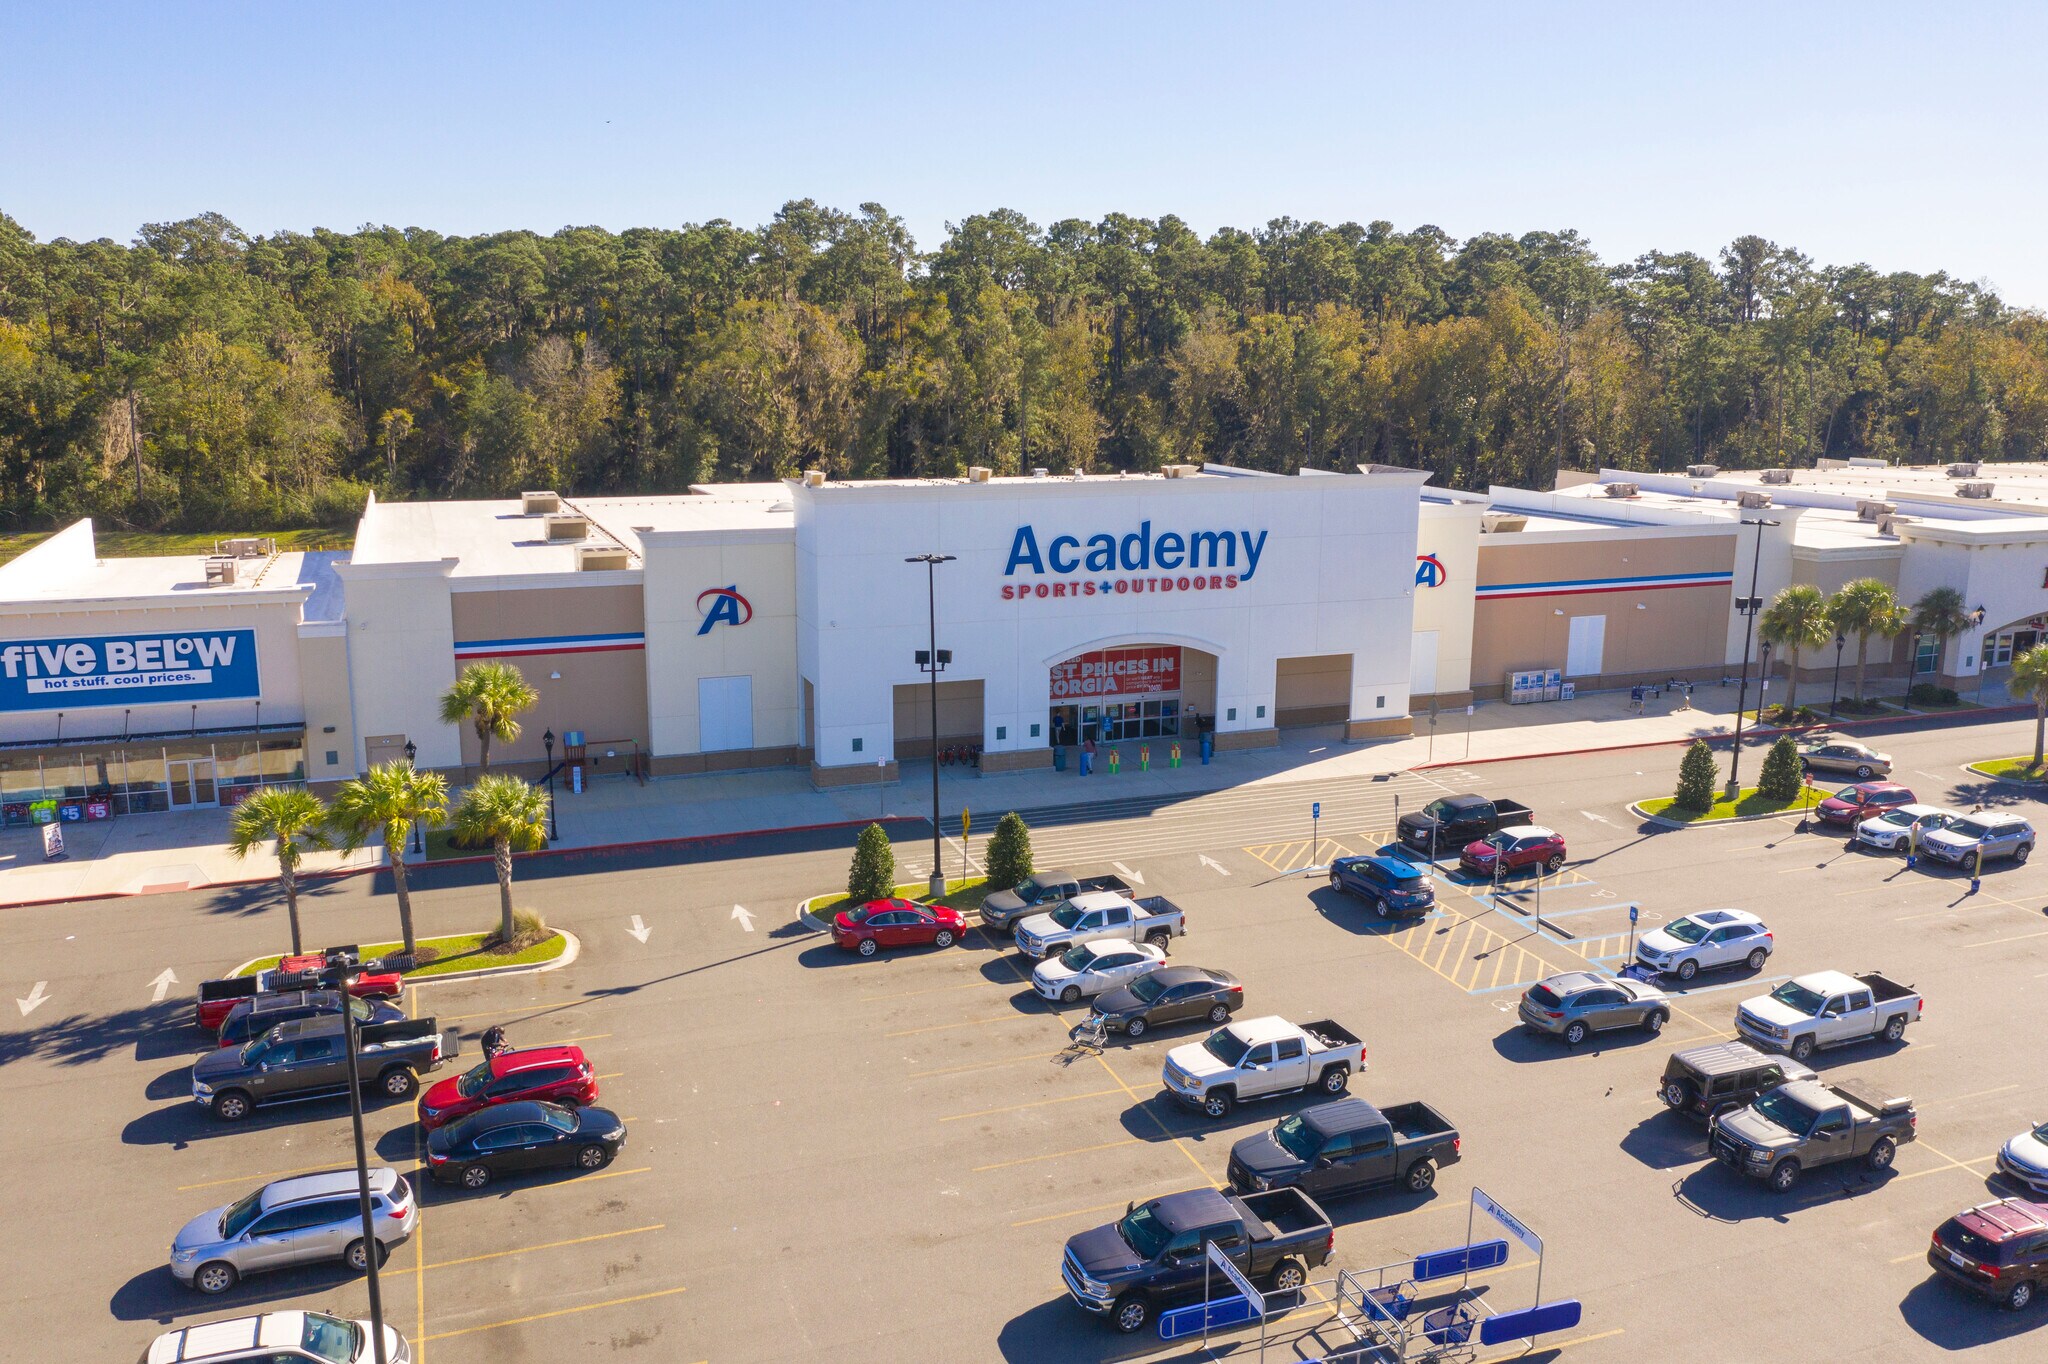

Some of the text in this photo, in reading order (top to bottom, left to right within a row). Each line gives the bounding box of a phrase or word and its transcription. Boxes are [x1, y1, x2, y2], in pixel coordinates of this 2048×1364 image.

[1002, 519, 1269, 582] Academy
[0, 643, 97, 678] five
[1051, 663, 1077, 680] ST
[1082, 659, 1148, 677] PRICES
[1153, 657, 1174, 672] IN
[44, 673, 196, 689] hot stuff. cool prices.
[1050, 677, 1118, 696] ORGIA
[34, 809, 52, 823] $5
[62, 807, 80, 820] $5
[89, 805, 107, 818] $5
[1496, 1209, 1525, 1239] Academy
